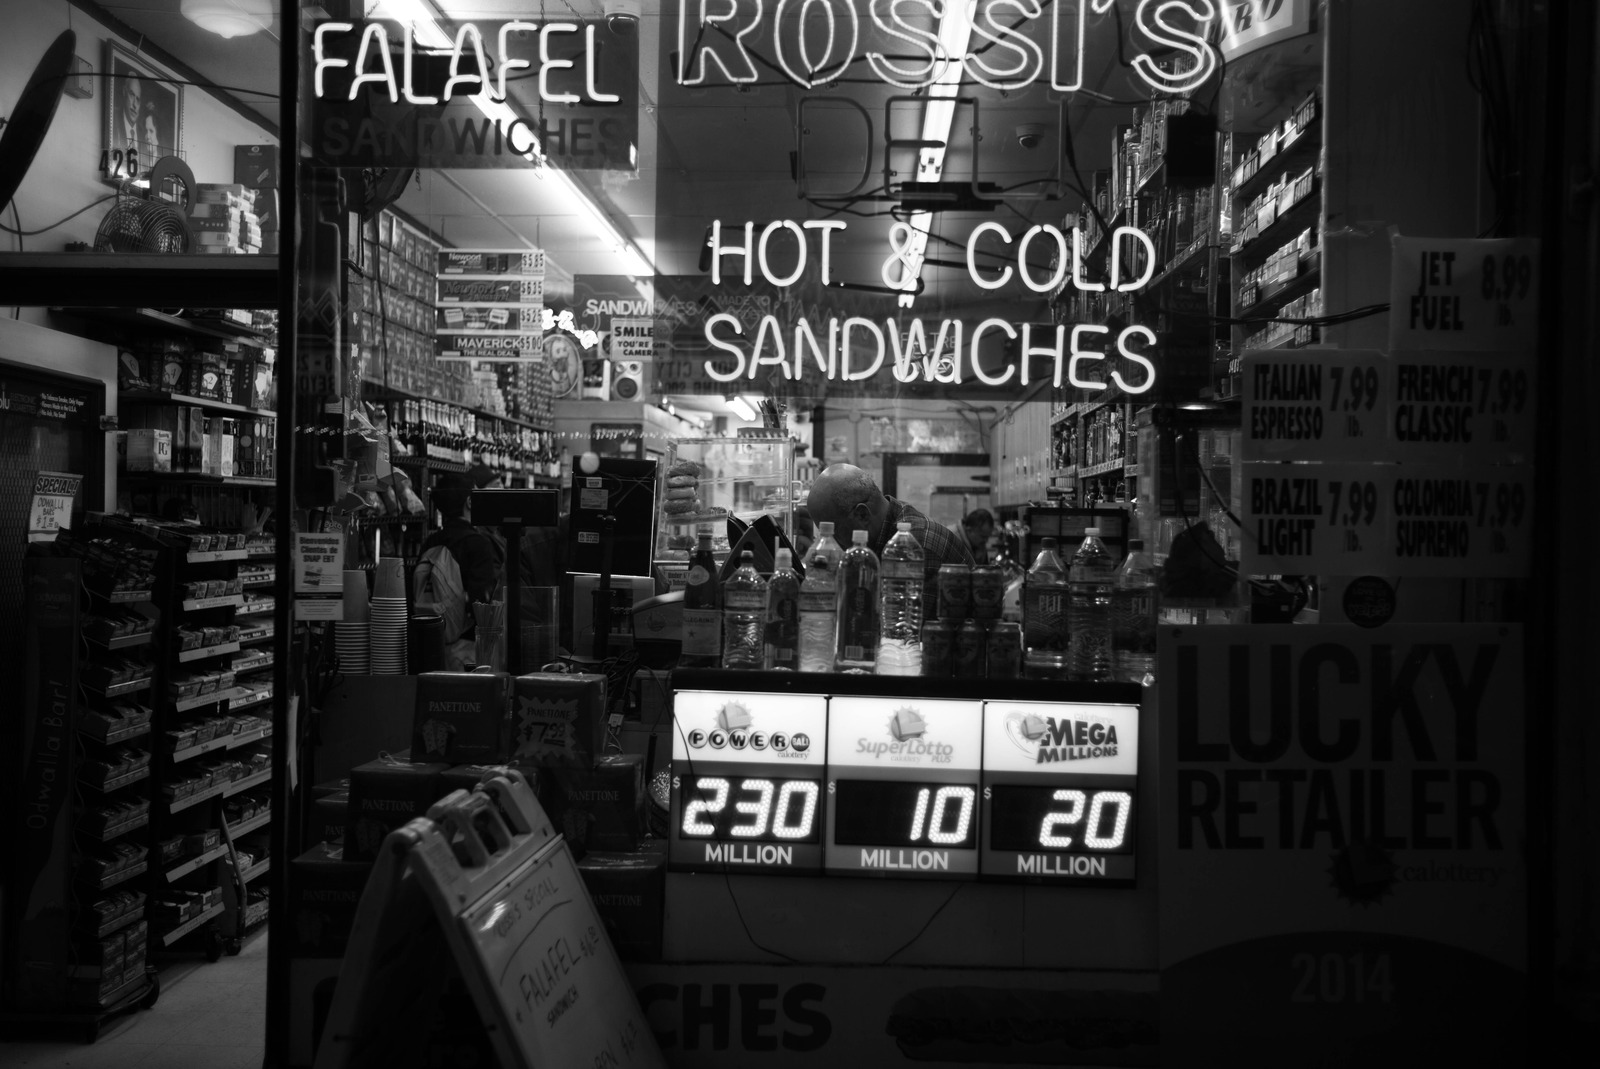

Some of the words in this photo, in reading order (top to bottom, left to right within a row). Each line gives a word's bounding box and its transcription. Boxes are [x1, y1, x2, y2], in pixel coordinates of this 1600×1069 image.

[315, 22, 621, 104] FALAFEL
[321, 117, 622, 156] SANDWICHES
[99, 148, 138, 178] 426
[711, 220, 847, 287] HOT
[882, 222, 924, 290] &
[967, 222, 1156, 292] COLD
[445, 281, 496, 295] Newport
[1418, 251, 1455, 297] JET
[1481, 254, 1531, 301] 8.99
[1409, 296, 1464, 331] FUEL
[457, 338, 519, 349] MAVERICK
[614, 326, 654, 338] SMILE
[704, 313, 1157, 394] SANDWICHES
[1253, 364, 1322, 401] ITALIAN
[1329, 366, 1379, 412] 7.99
[1397, 365, 1474, 402] FRENCH
[1478, 368, 1528, 415] 7.99
[1251, 405, 1323, 440] ESPRESSO
[1395, 405, 1473, 443] CLASSIC
[36, 476, 80, 496] SPECIAL!
[37, 497, 64, 512] ODWALLA
[43, 508, 55, 516] BARS
[1251, 478, 1322, 516] BRAZIL
[1328, 481, 1377, 527] 7.99
[1394, 479, 1474, 517] COLOMBIA
[1476, 482, 1526, 529] 7.99
[299, 537, 339, 545] Bienvenidos
[300, 546, 327, 554] Clientes
[1257, 519, 1315, 556] LIGHT
[1396, 520, 1469, 558] SUPREMO
[303, 555, 321, 563] SNAP
[322, 555, 335, 563] EBT
[41, 679, 69, 728] Bar!
[428, 701, 481, 713] PANETTONE
[526, 707, 571, 720] PANETTONE
[1176, 643, 1501, 763] LUCKY
[690, 730, 789, 750] POWER
[855, 737, 954, 759] SuperLotto
[1041, 717, 1118, 747] MEGA
[777, 750, 809, 760] calottery
[1036, 745, 1118, 764] MILLIONS
[26, 735, 61, 830] Odwalla
[567, 790, 620, 801] PANETTONE
[362, 798, 415, 812] PANETTONE
[682, 777, 819, 839] 230
[908, 785, 976, 845] 10
[1038, 789, 1132, 850] 20
[1177, 769, 1503, 850] RETAILER
[705, 843, 792, 865] MILLION
[860, 849, 949, 871] MILLION
[1017, 855, 1106, 877] MILLION
[1403, 860, 1501, 887] calottery
[303, 889, 358, 903] PANETTONE
[519, 936, 581, 1013] FALAFEL
[1290, 951, 1396, 1004] 2014
[547, 984, 580, 1028] SANDWICH
